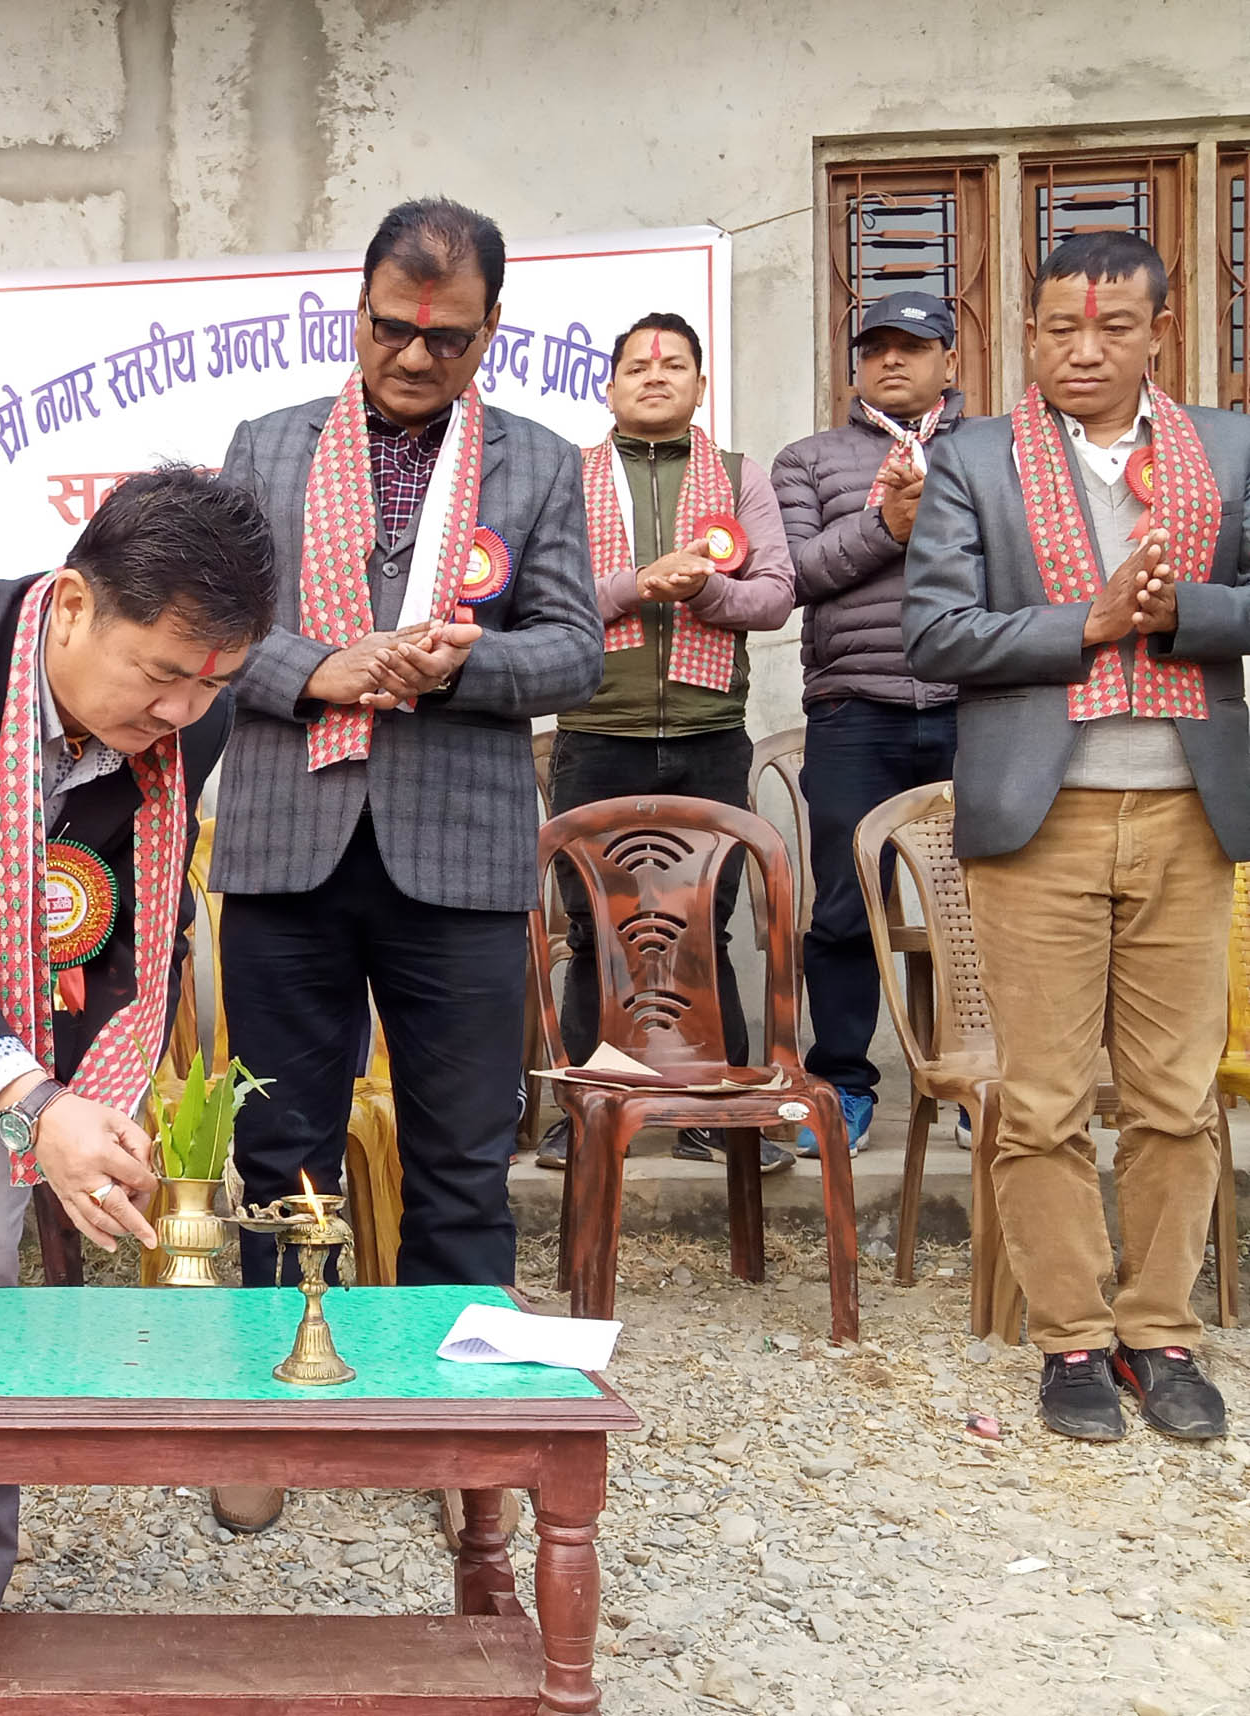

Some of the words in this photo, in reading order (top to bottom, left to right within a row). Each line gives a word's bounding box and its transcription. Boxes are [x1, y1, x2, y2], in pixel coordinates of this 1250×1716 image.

[31, 362, 101, 434] नगर
[104, 321, 197, 409] स्तरीय
[203, 313, 290, 378] अन्तर
[299, 291, 358, 364] विद्या
[484, 323, 535, 393] कुद
